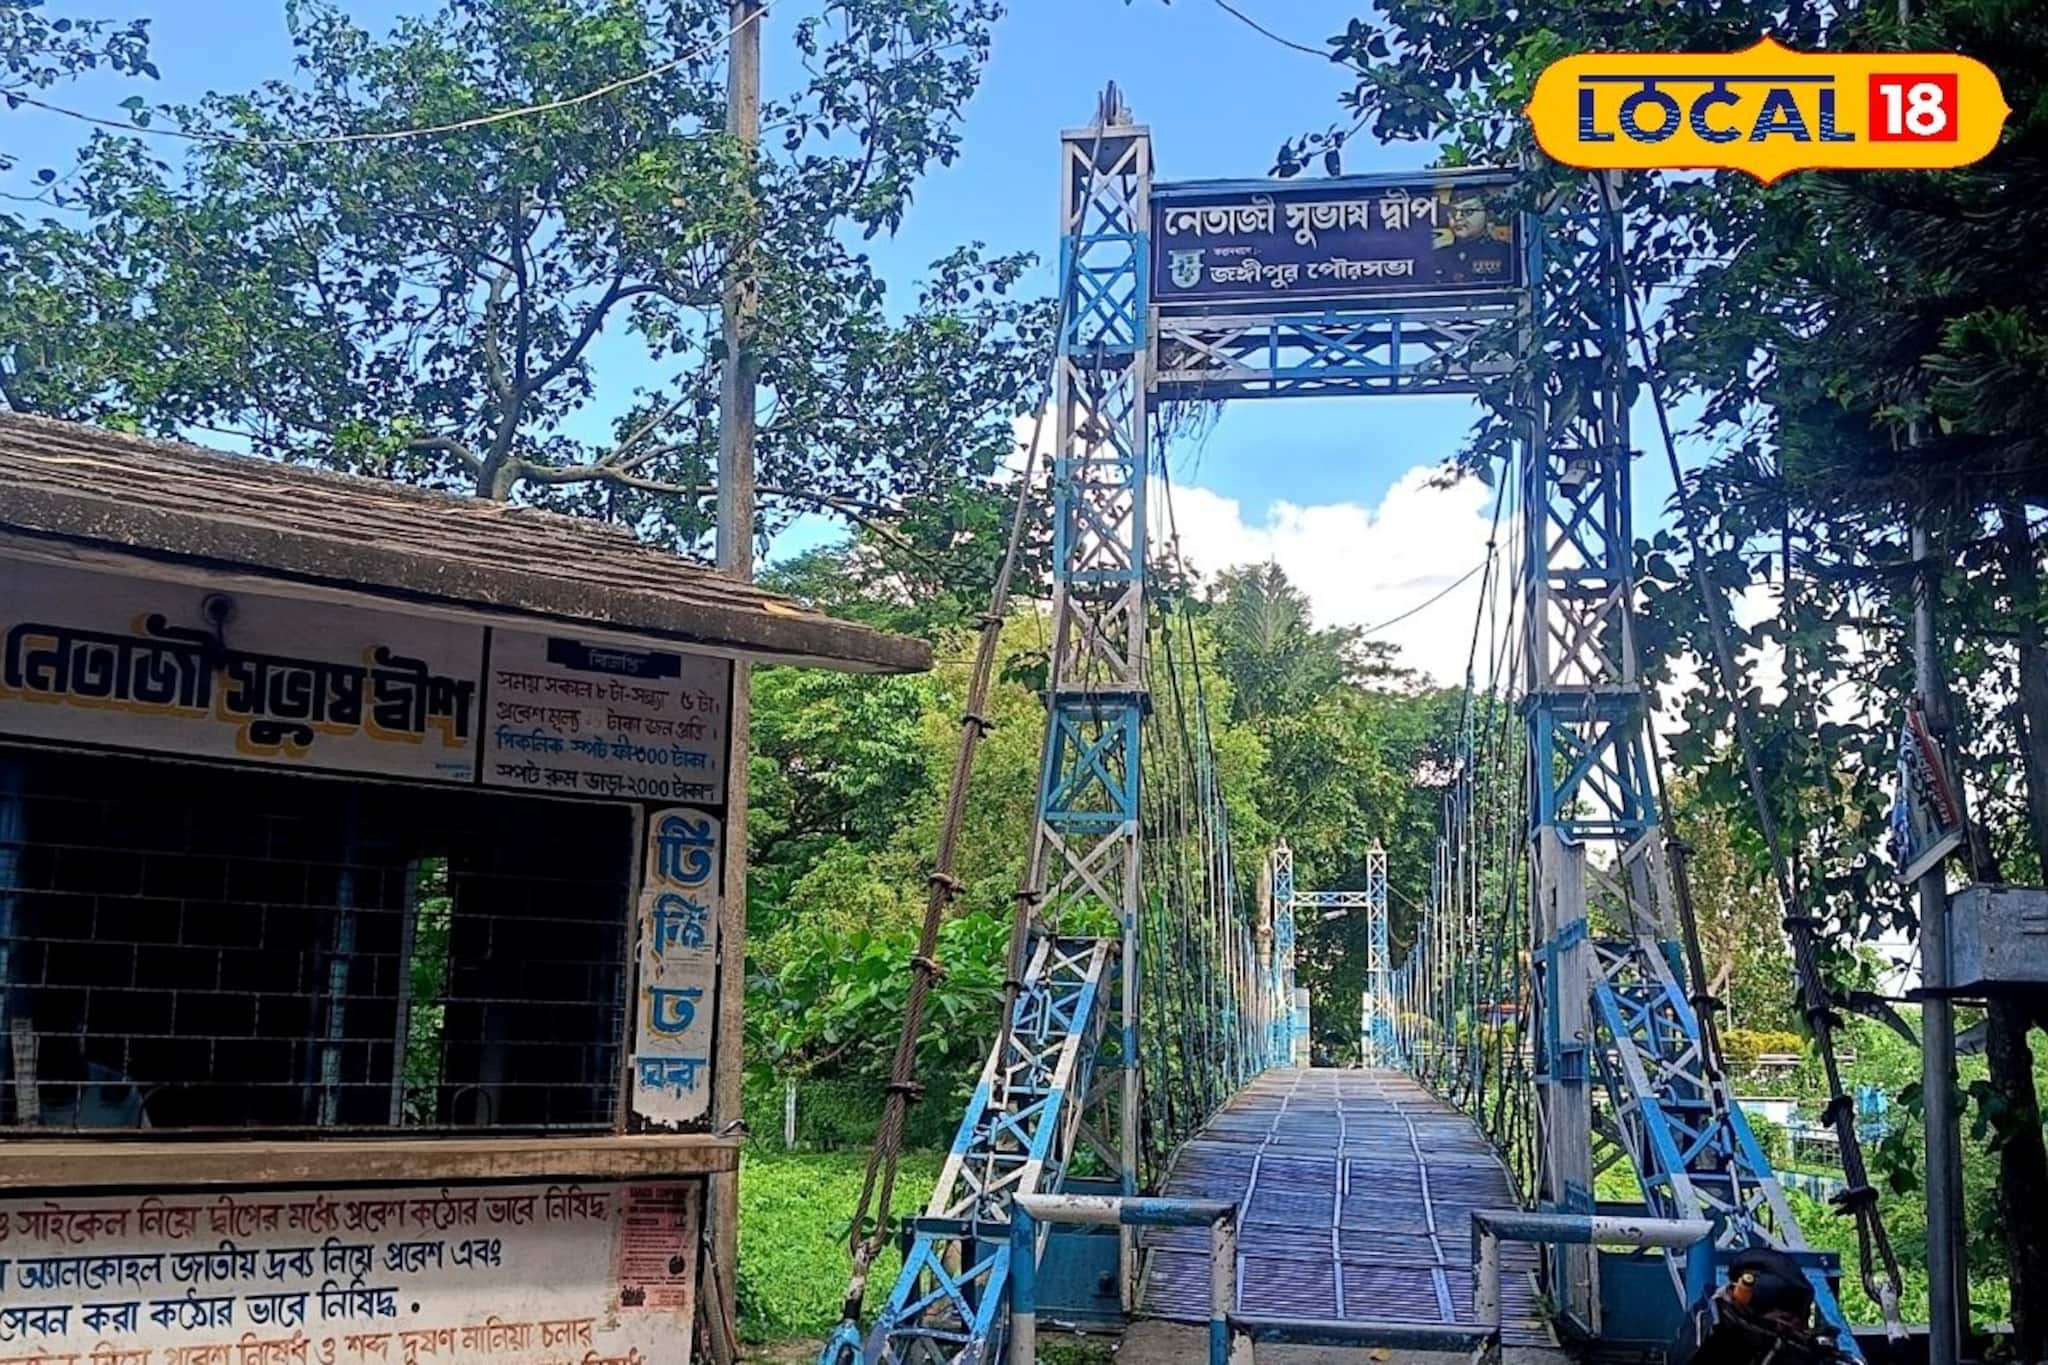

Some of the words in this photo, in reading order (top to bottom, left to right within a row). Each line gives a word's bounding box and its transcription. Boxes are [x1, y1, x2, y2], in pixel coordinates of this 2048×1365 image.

[1165, 194, 1275, 237] নেতাজী
[1285, 200, 1369, 250] সুভাষ
[1380, 188, 1438, 230] দ্বীপ
[1209, 258, 1299, 289] জঙ্গীপুর
[1307, 256, 1414, 280] পৌরসভা
[3, 613, 213, 714] নেতাজী
[217, 648, 367, 755] সুভাষ
[366, 645, 475, 742] দ্বীপ
[607, 707, 641, 731] টাকা
[17, 1201, 131, 1246] সাইকেল
[138, 1198, 202, 1241] নিয়ে
[207, 1195, 284, 1237] দ্বীপের
[343, 1199, 406, 1233] প্রবেশ
[409, 1188, 481, 1231] কঠোর
[485, 1195, 538, 1228] ভাবে
[544, 1186, 611, 1221] নিষিদ্ধ
[17, 1254, 166, 1291] অ্যালকোহল
[171, 1239, 260, 1284] জাতীয়
[321, 1237, 374, 1275] নিয়ে
[383, 1240, 445, 1272] প্রবেশ
[451, 1239, 502, 1269] এবং
[0, 1305, 72, 1341] সেবন
[82, 1301, 140, 1333] করা
[150, 1287, 236, 1331] কঠোর
[245, 1293, 309, 1328] ভাবে
[316, 1280, 398, 1320] নিষিদ্ধ
[461, 1316, 534, 1351] মানিয়া
